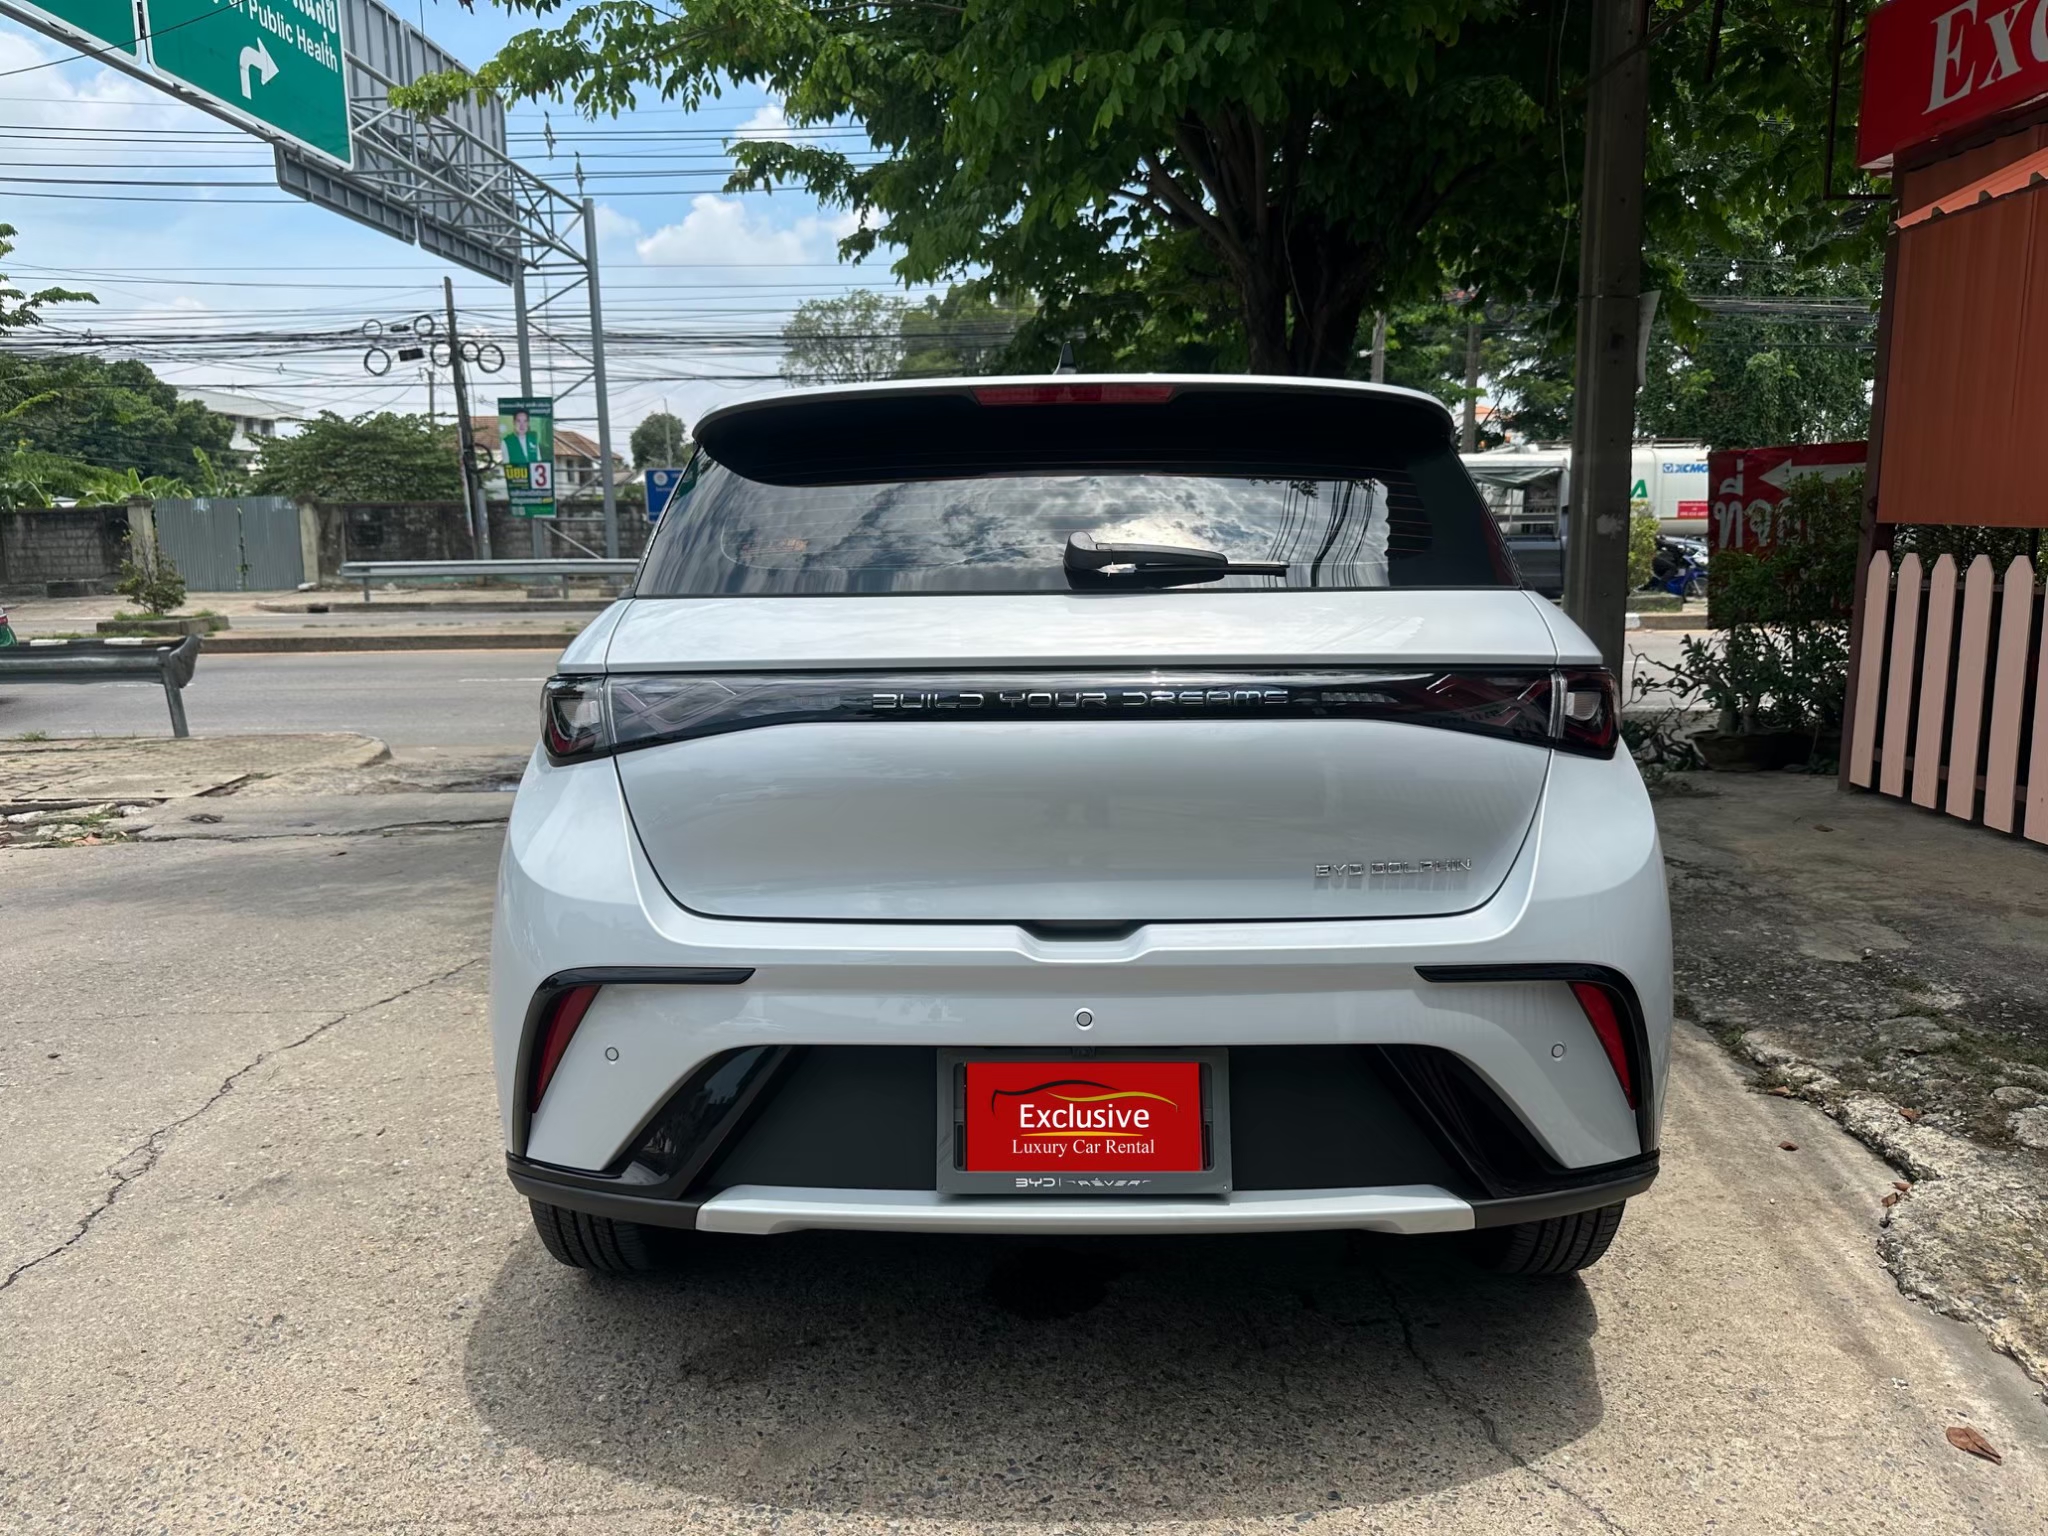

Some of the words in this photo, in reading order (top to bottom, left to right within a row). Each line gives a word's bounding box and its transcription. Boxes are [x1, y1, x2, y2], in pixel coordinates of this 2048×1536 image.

[248, 0, 293, 44] Public
[296, 24, 338, 73] Health
[535, 464, 547, 487] 3
[872, 693, 984, 709] BUILD
[1000, 692, 1107, 708] YOUR
[1122, 690, 1289, 706] DREAMS
[1315, 863, 1364, 877] BYD
[1371, 858, 1472, 875] DOLPHIN
[1019, 1103, 1150, 1129] Exclusive
[1012, 1139, 1068, 1158] Luxury
[1072, 1139, 1101, 1154] Car
[1105, 1139, 1155, 1154] Rental
[1015, 1177, 1056, 1188] BYD
